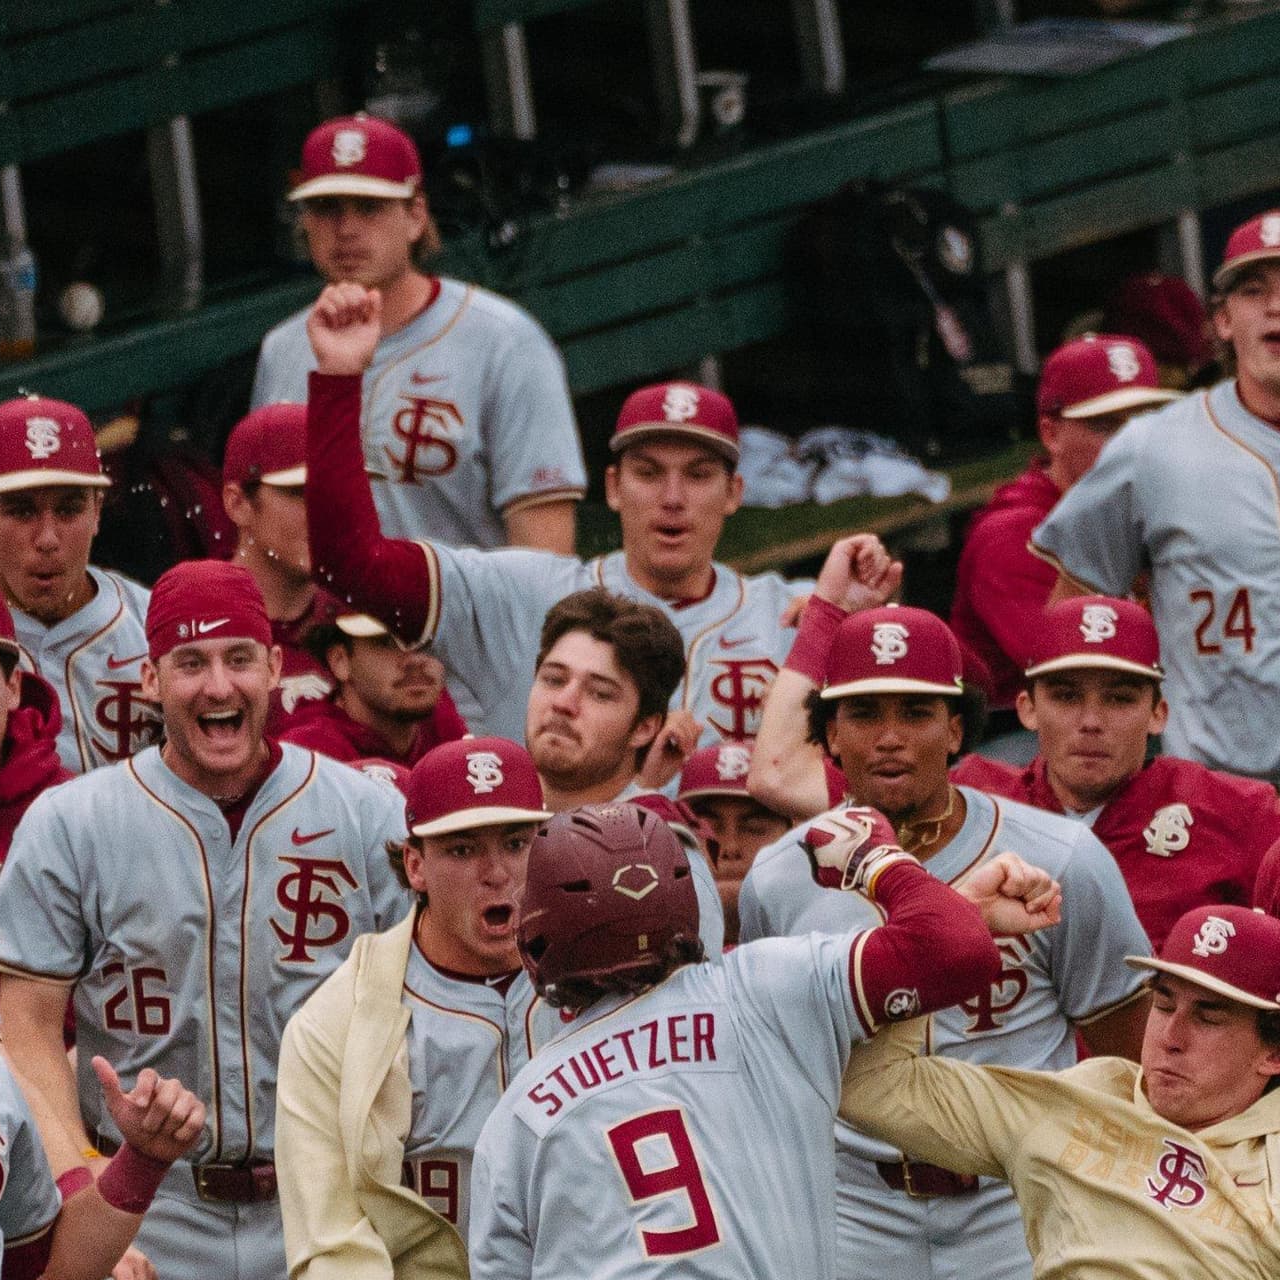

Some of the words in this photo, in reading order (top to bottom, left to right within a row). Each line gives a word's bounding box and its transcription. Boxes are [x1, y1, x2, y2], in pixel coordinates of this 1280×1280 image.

[1188, 586, 1256, 656] 24
[101, 962, 171, 1036] 26
[527, 1012, 717, 1117] STUETZER
[606, 1107, 721, 1258] 9
